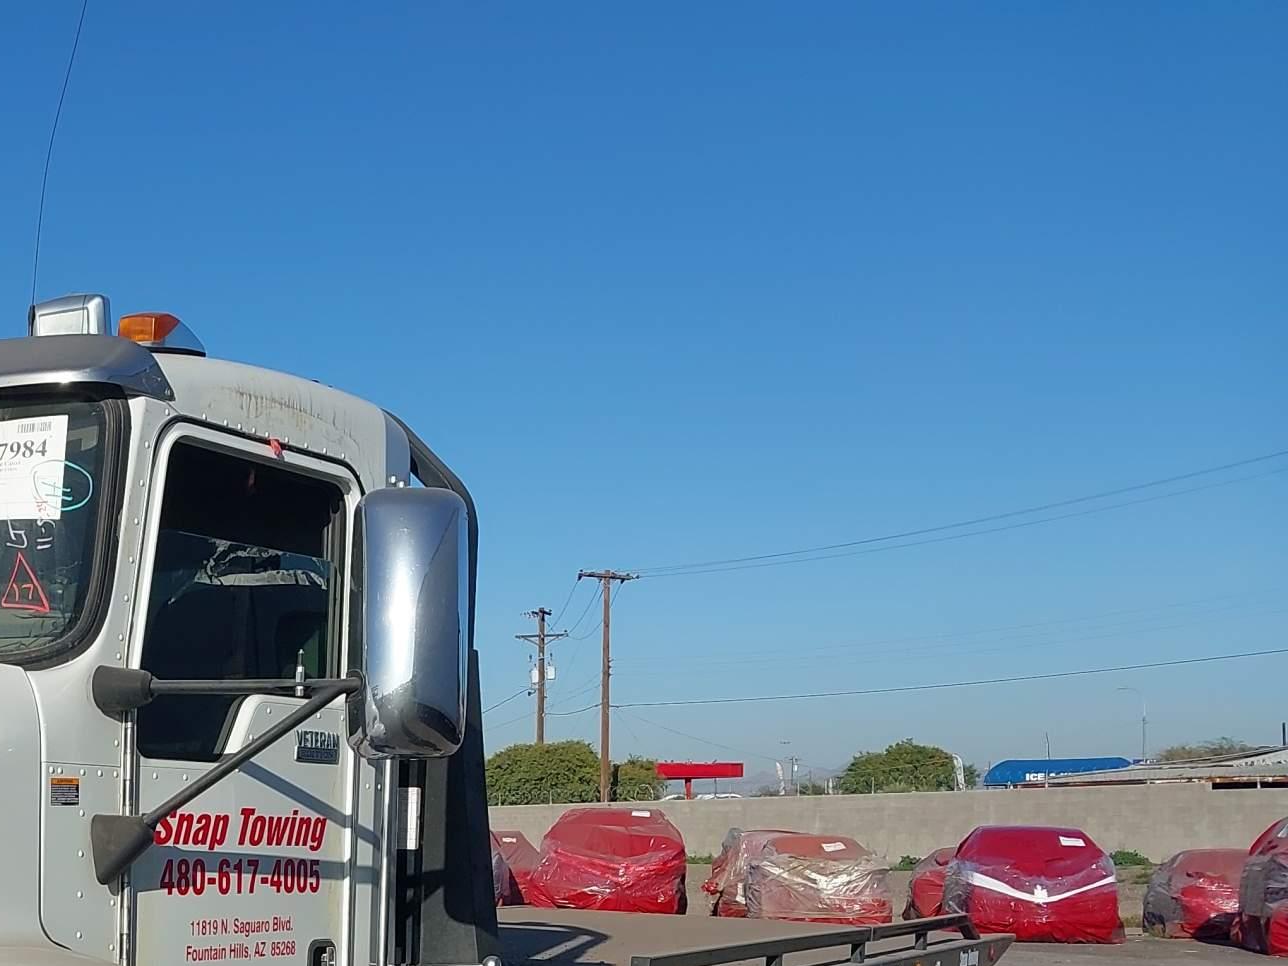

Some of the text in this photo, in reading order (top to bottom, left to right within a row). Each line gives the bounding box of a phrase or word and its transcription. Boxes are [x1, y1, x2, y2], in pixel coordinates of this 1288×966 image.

[1025, 773, 1045, 781] ICE
[153, 808, 327, 850] Snap Towing
[160, 857, 321, 896] 480-617-4005
[190, 916, 294, 937] 11819 N. Saguaro Blvd.
[186, 940, 297, 962] Fountain Hills, AZ 85268
